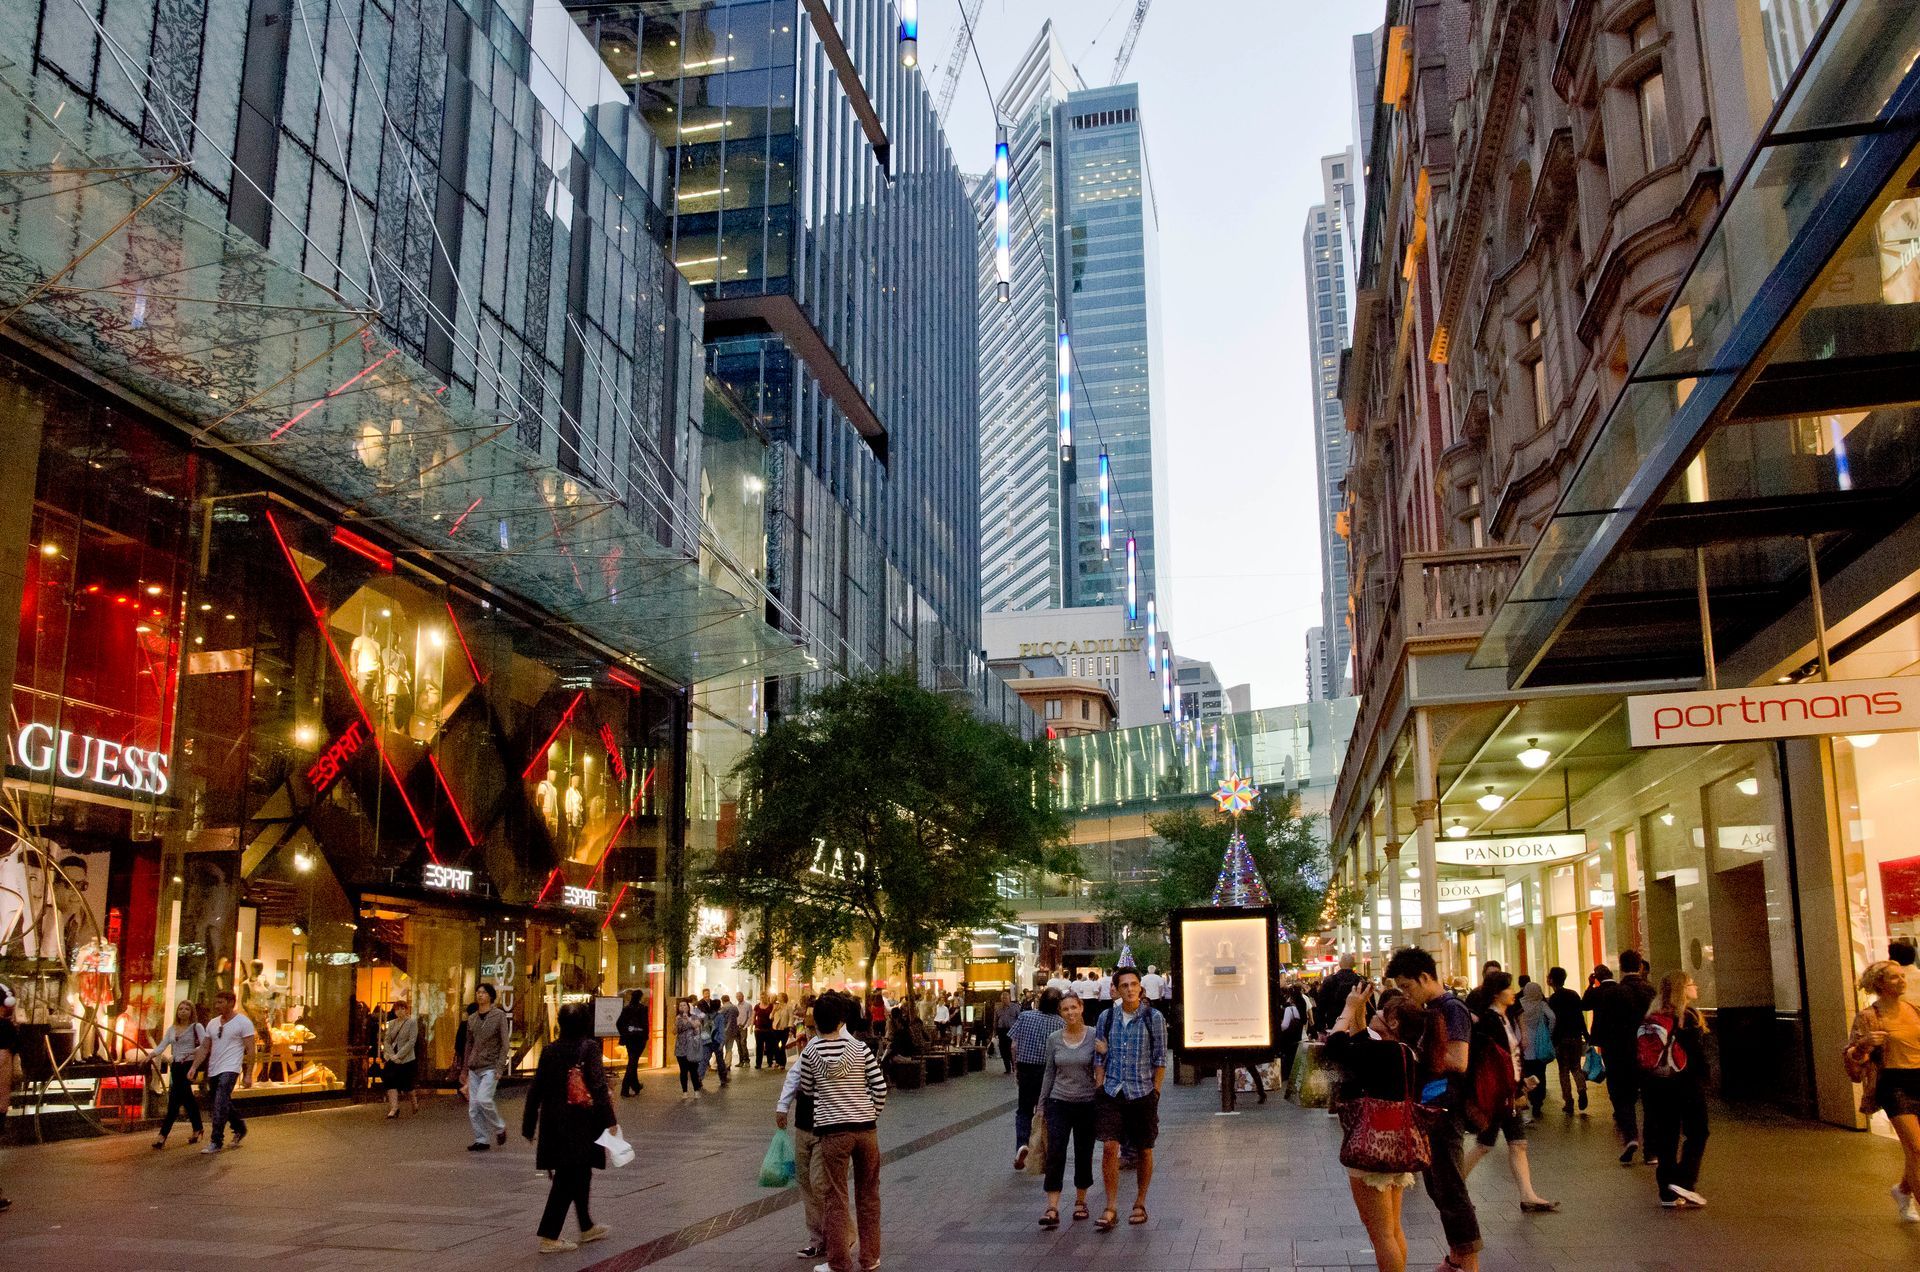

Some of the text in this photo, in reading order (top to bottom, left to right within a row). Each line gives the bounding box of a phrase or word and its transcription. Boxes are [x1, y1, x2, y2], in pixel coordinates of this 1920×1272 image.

[1019, 637, 1145, 656] PICCADILLY
[1653, 691, 1902, 740] portmans
[17, 722, 169, 796] GUESS
[307, 720, 363, 792] ESPRIT
[1465, 842, 1557, 861] PANDORA
[425, 864, 473, 891] ESPRIT
[564, 885, 598, 908] ESPRIT
[1413, 884, 1481, 899] PDORA
